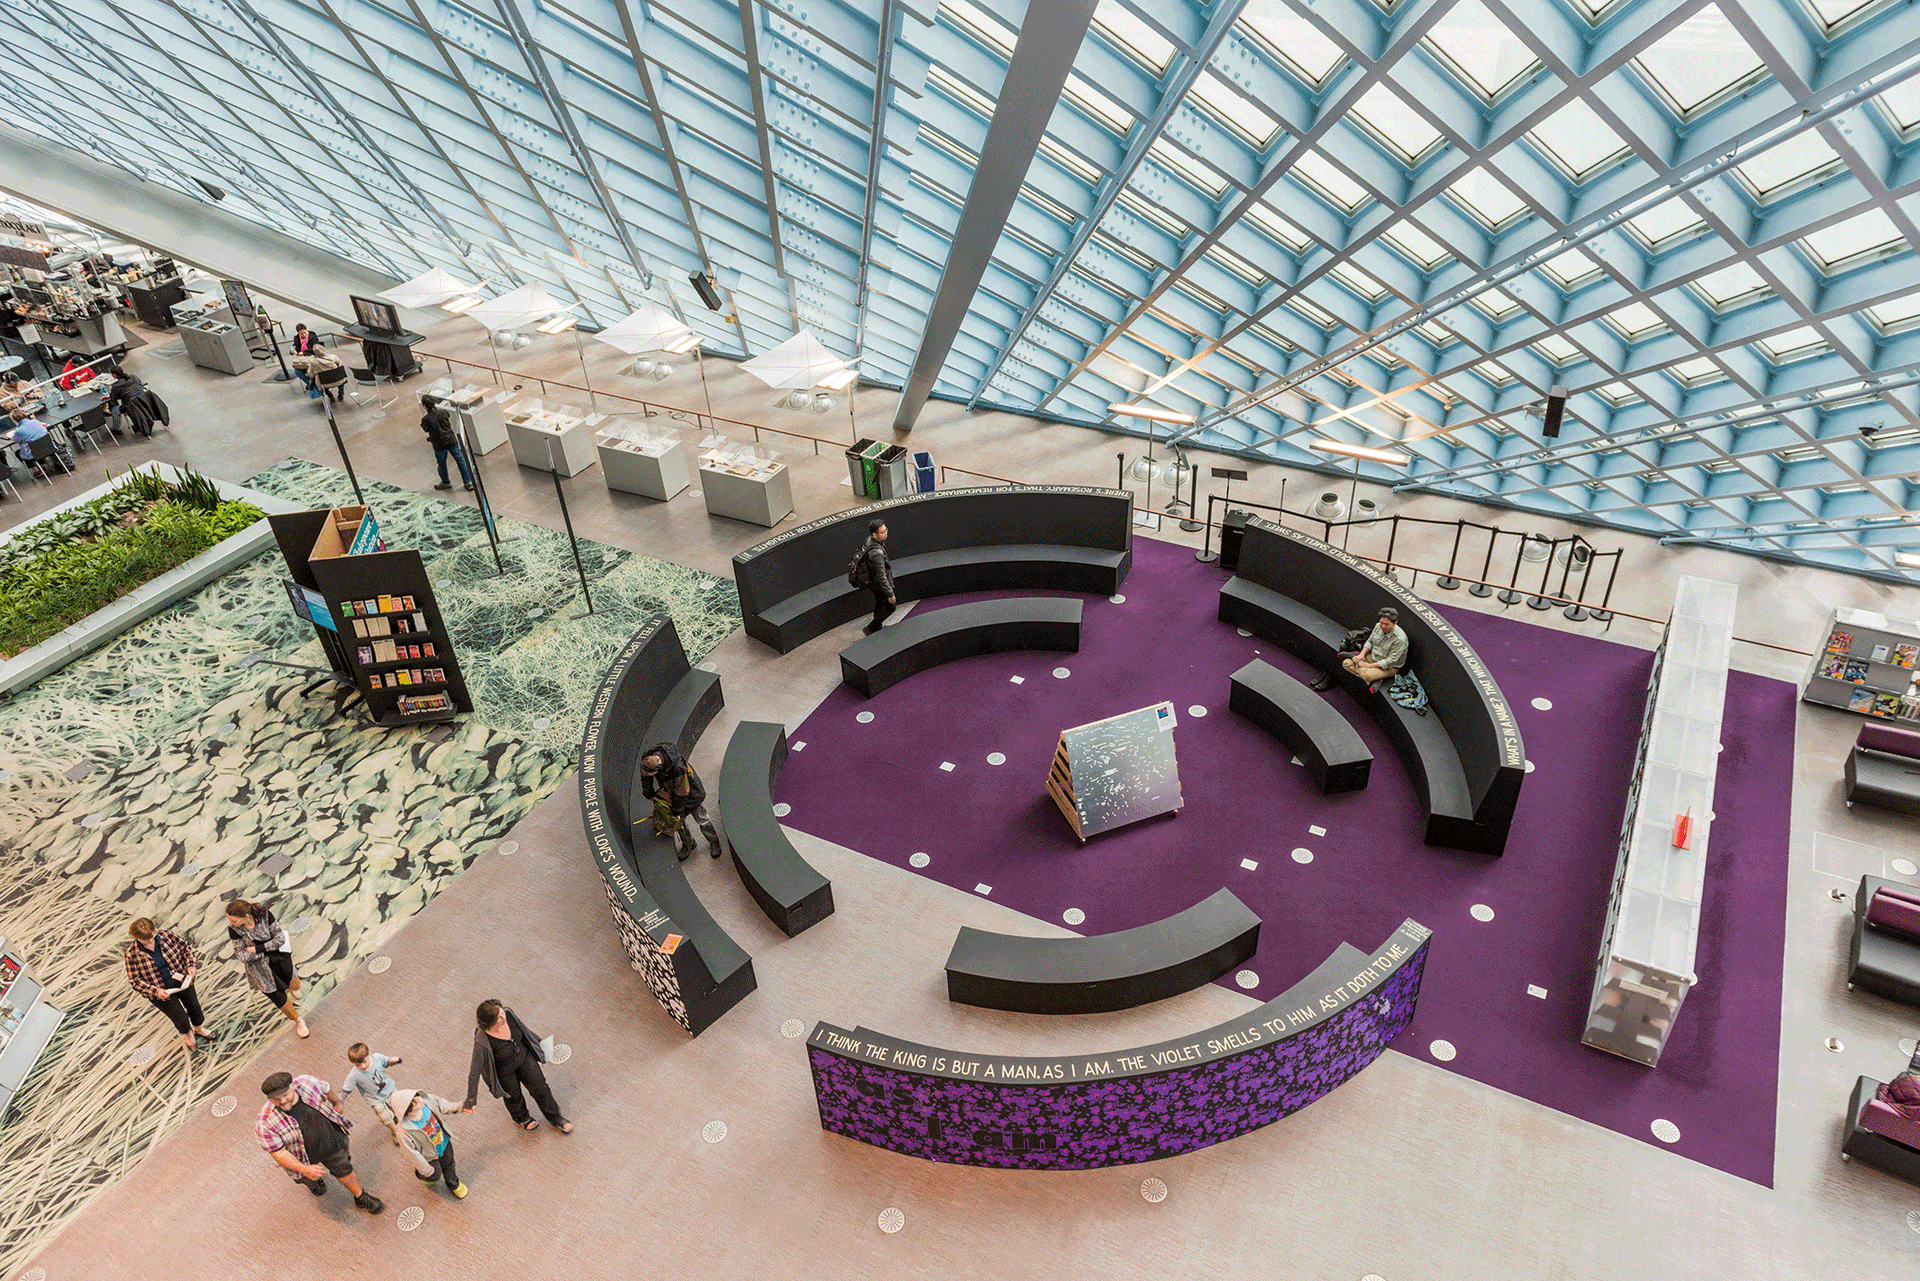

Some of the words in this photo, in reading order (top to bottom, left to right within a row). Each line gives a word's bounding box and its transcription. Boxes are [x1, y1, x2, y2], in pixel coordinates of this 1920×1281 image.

[997, 485, 1013, 493] FOR
[1014, 484, 1043, 493] THAT'S
[1095, 488, 1129, 498] THERE'S
[885, 497, 907, 507] THERE
[812, 515, 839, 527] THAT'S
[796, 525, 813, 534] FOR
[1292, 532, 1306, 540] AS
[1304, 537, 1330, 551] SMELL
[1329, 548, 1358, 566] WOULD
[1356, 563, 1381, 578] NAME
[1377, 576, 1404, 593] OTHER
[1400, 592, 1420, 604] ANY
[1413, 603, 1427, 612] BY
[650, 619, 662, 627] IT
[1421, 610, 1444, 627] ROSE
[636, 626, 655, 640] FELL
[1444, 631, 1464, 647] CALL
[625, 640, 642, 659] UPON
[1456, 646, 1472, 658] WE
[605, 664, 625, 686] LITTLE
[1464, 657, 1487, 679] WHICH
[1479, 679, 1497, 696] THAT
[592, 686, 614, 719] WESTERN
[1489, 697, 1510, 721] NAME?
[1502, 727, 1516, 736] IN
[1504, 737, 1520, 766] WHAT'S
[583, 754, 595, 774] NOW
[583, 778, 599, 808] PURPLE
[588, 807, 604, 833] WITH
[594, 833, 616, 863] LOVE'S
[815, 1029, 825, 1042] I
[826, 1031, 862, 1054] THINK
[865, 1043, 890, 1062] THE
[892, 1051, 928, 1069] KING
[931, 1057, 947, 1072] IS
[951, 1060, 981, 1076] BUT
[983, 1064, 996, 1078] A
[1043, 1064, 1065, 1079] AS
[1070, 1063, 1076, 1078] I
[1084, 1061, 1115, 1077] AM.
[1116, 1055, 1148, 1072] THE
[1150, 1044, 1203, 1067] VIOLET
[1206, 1027, 1262, 1055] SMELLS
[1262, 1017, 1287, 1036] TO
[1286, 1005, 1318, 1027] HIM
[1317, 993, 1340, 1013] AS
[1333, 986, 1351, 1002] IT
[1346, 966, 1380, 994] DOTH
[1371, 956, 1393, 972] TO
[1385, 943, 1409, 962] ME.
